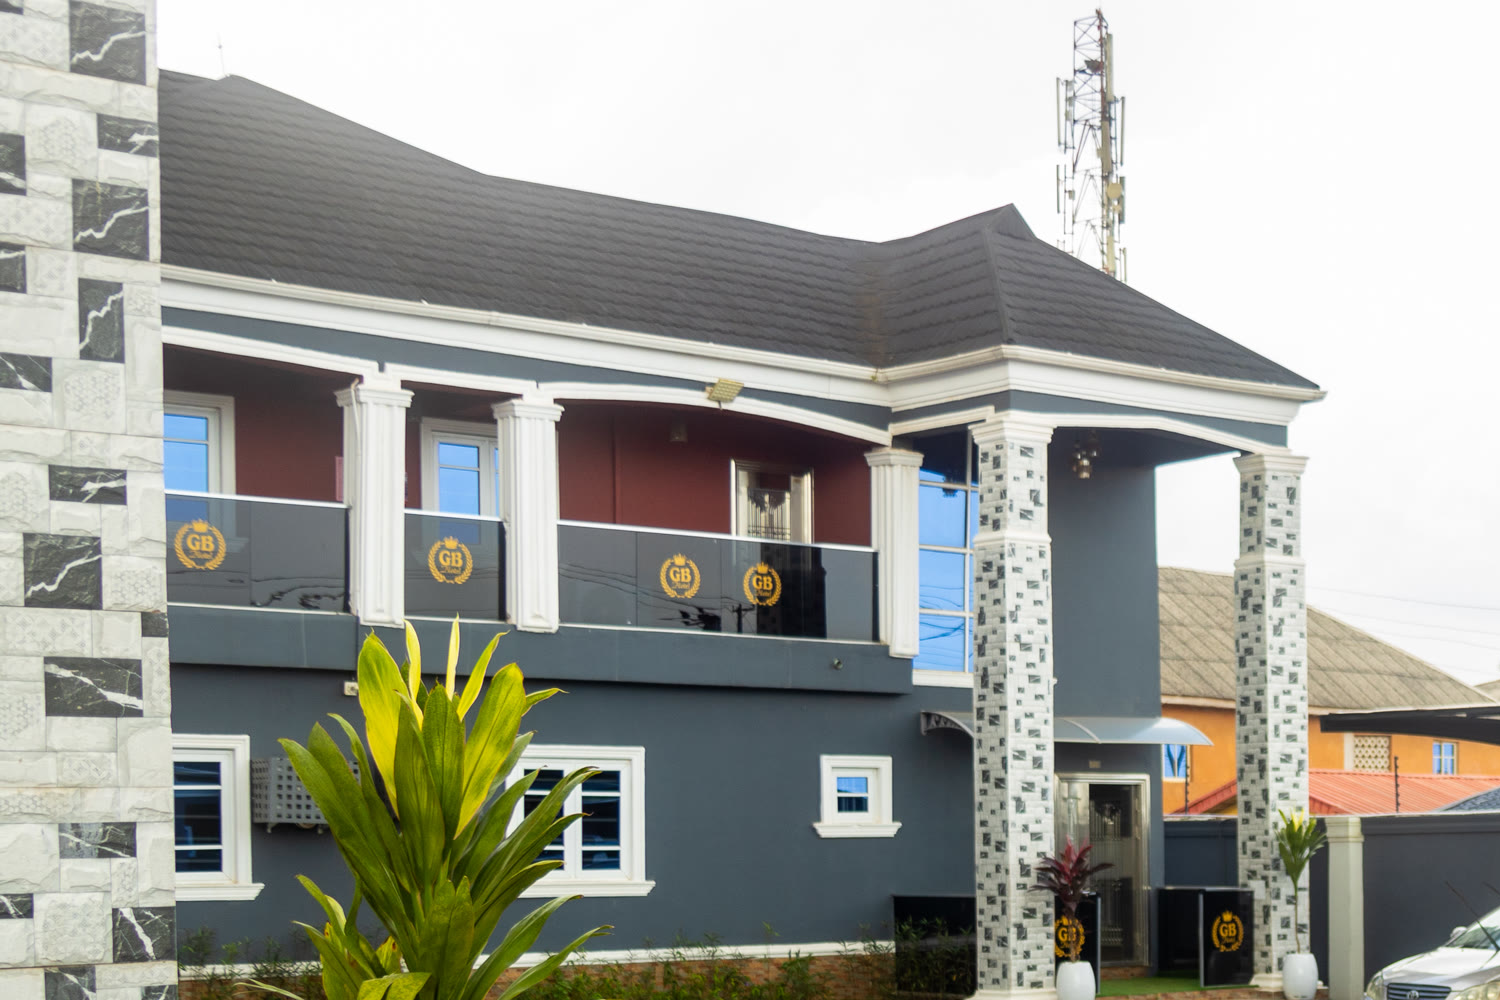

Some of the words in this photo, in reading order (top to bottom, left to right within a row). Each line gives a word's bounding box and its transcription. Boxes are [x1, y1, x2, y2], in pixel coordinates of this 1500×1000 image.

[186, 533, 215, 552] GB
[438, 550, 463, 567] GB
[669, 567, 692, 583] GB
[752, 575, 773, 591] GB
[1219, 923, 1237, 937] GB
